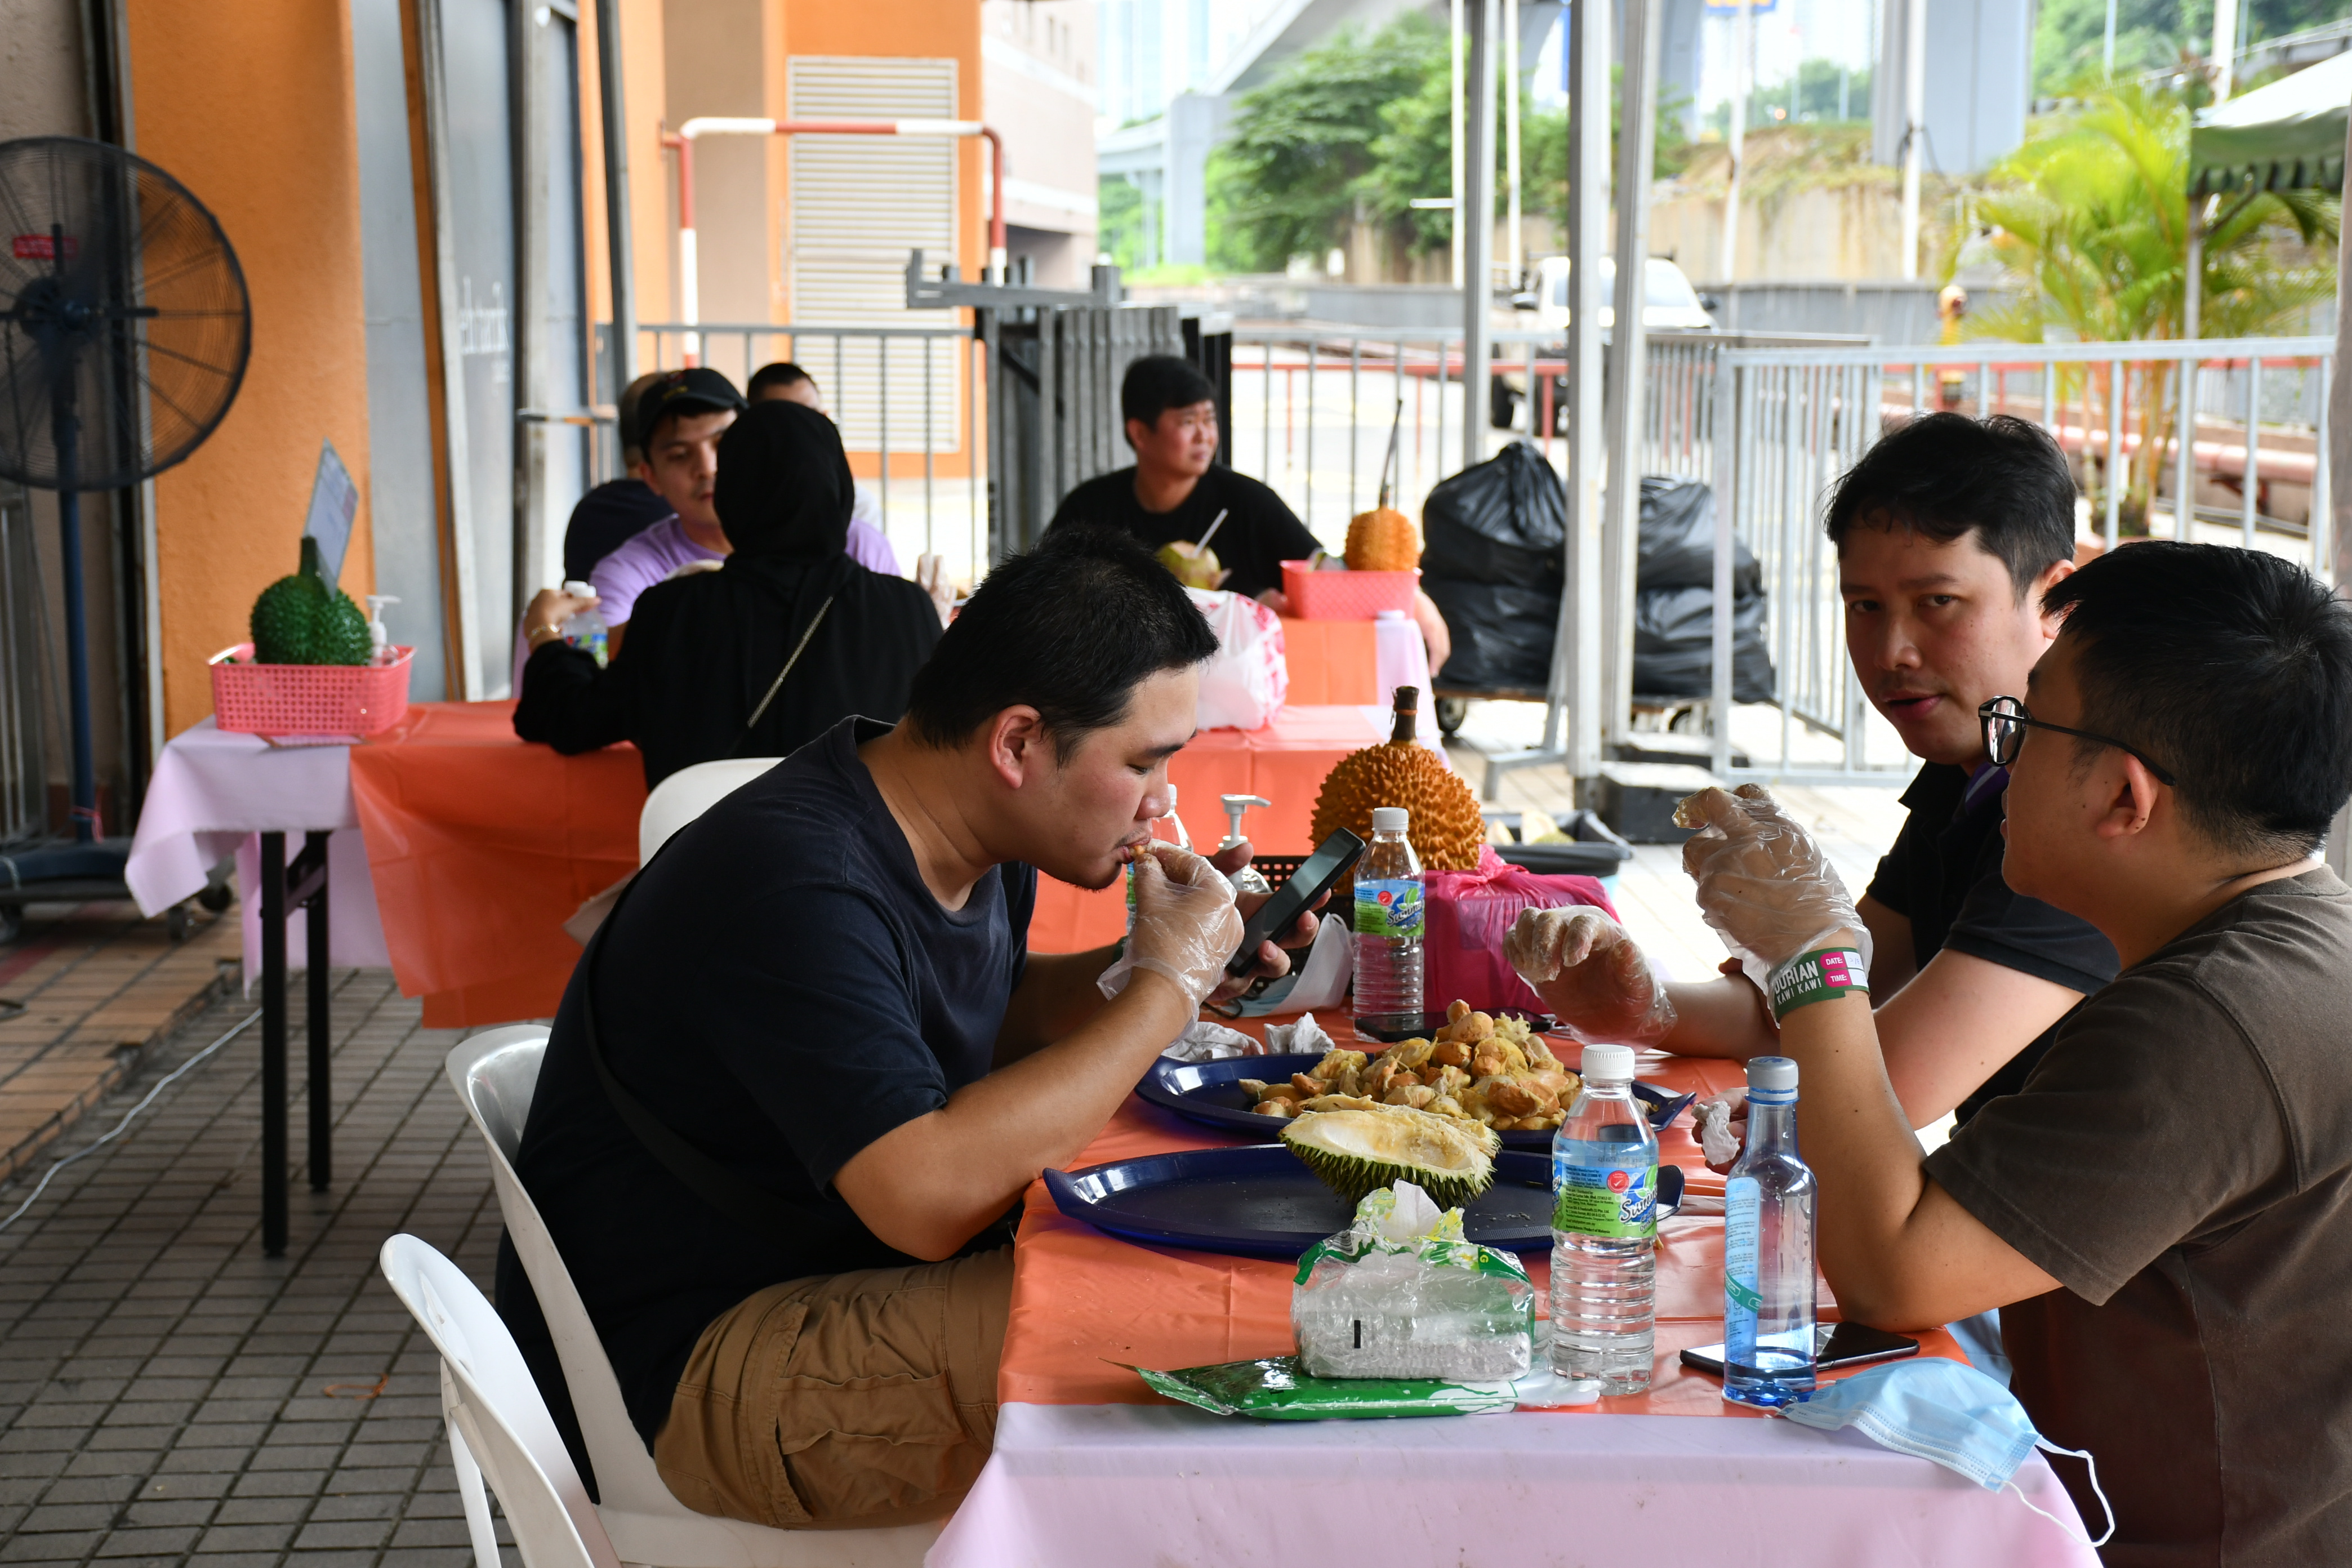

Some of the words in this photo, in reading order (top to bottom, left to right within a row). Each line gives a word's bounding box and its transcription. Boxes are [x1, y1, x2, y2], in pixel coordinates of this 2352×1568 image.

[1825, 957, 1843, 965] DATE:
[1777, 987, 1794, 1005] KAW!
[1797, 978, 1822, 994] KAW!
